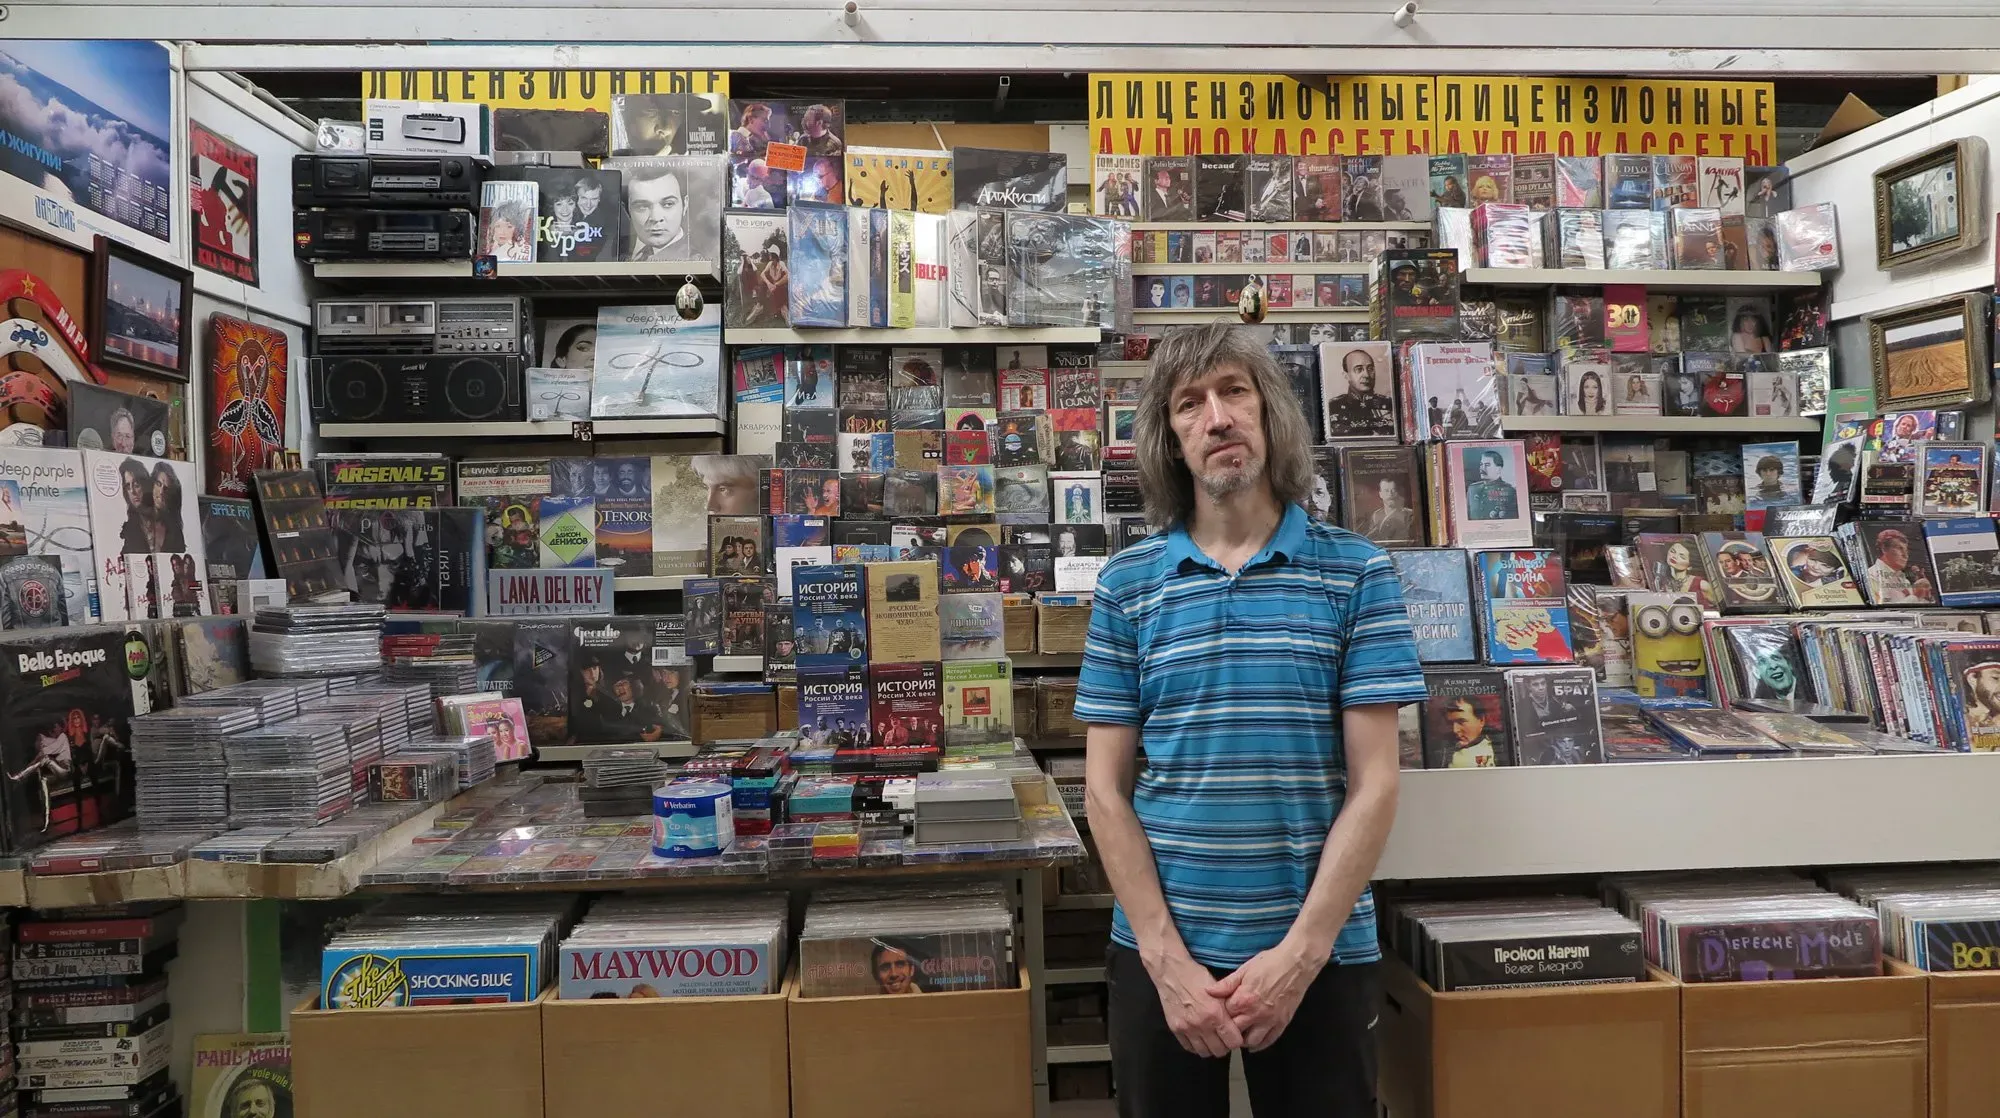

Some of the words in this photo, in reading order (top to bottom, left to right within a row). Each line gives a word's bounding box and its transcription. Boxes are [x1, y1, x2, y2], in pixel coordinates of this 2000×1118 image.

[1096, 80, 1429, 124] ЛИЦЕНЗИОННЫЕ
[1445, 83, 1768, 127] ЛИЦЕНЗИОННЫЕ
[9, 132, 62, 171] ЖИГУЛИ!
[1097, 158, 1113, 168] TOM
[1114, 158, 1140, 168] JONES
[1623, 165, 1648, 174] DIVO
[1528, 182, 1553, 191] DYLAN
[736, 218, 749, 227] the
[750, 219, 773, 227] verve
[537, 216, 603, 256] Кураж
[626, 313, 654, 326] deep
[655, 314, 683, 327] purp
[1607, 304, 1640, 328] 30
[640, 326, 677, 337] infinite
[1059, 396, 1096, 409] LOUNA
[33, 463, 74, 482] purple
[336, 466, 446, 483] ARSENAL-5
[503, 465, 534, 474] STEREO
[17, 482, 60, 501] infinite
[211, 503, 236, 516] SPACE
[549, 537, 588, 546] ДЕНИСОВ
[1507, 571, 1545, 583] ВОЙНА
[500, 576, 540, 604] LANA
[544, 576, 571, 604] DEL
[574, 575, 603, 604] REY
[799, 582, 858, 595] ИСТОРИЯ
[18, 653, 55, 673] Belle
[56, 649, 106, 671] Epoque
[483, 681, 513, 690] WATERS
[804, 683, 863, 695] ИСТОРИЯ
[877, 679, 936, 692] ИСТОРИЯ
[1554, 685, 1589, 697] БРАТ
[669, 801, 697, 809] Verbatim
[1494, 946, 1544, 963] Прокол
[1548, 945, 1590, 960] Харум
[571, 948, 760, 980] MAYWOOD
[411, 974, 480, 989] SHOCKING
[481, 973, 513, 987] BLUE
[196, 1049, 243, 1067] PAUL
[252, 1067, 271, 1079] vole
[271, 1072, 288, 1088] vole
